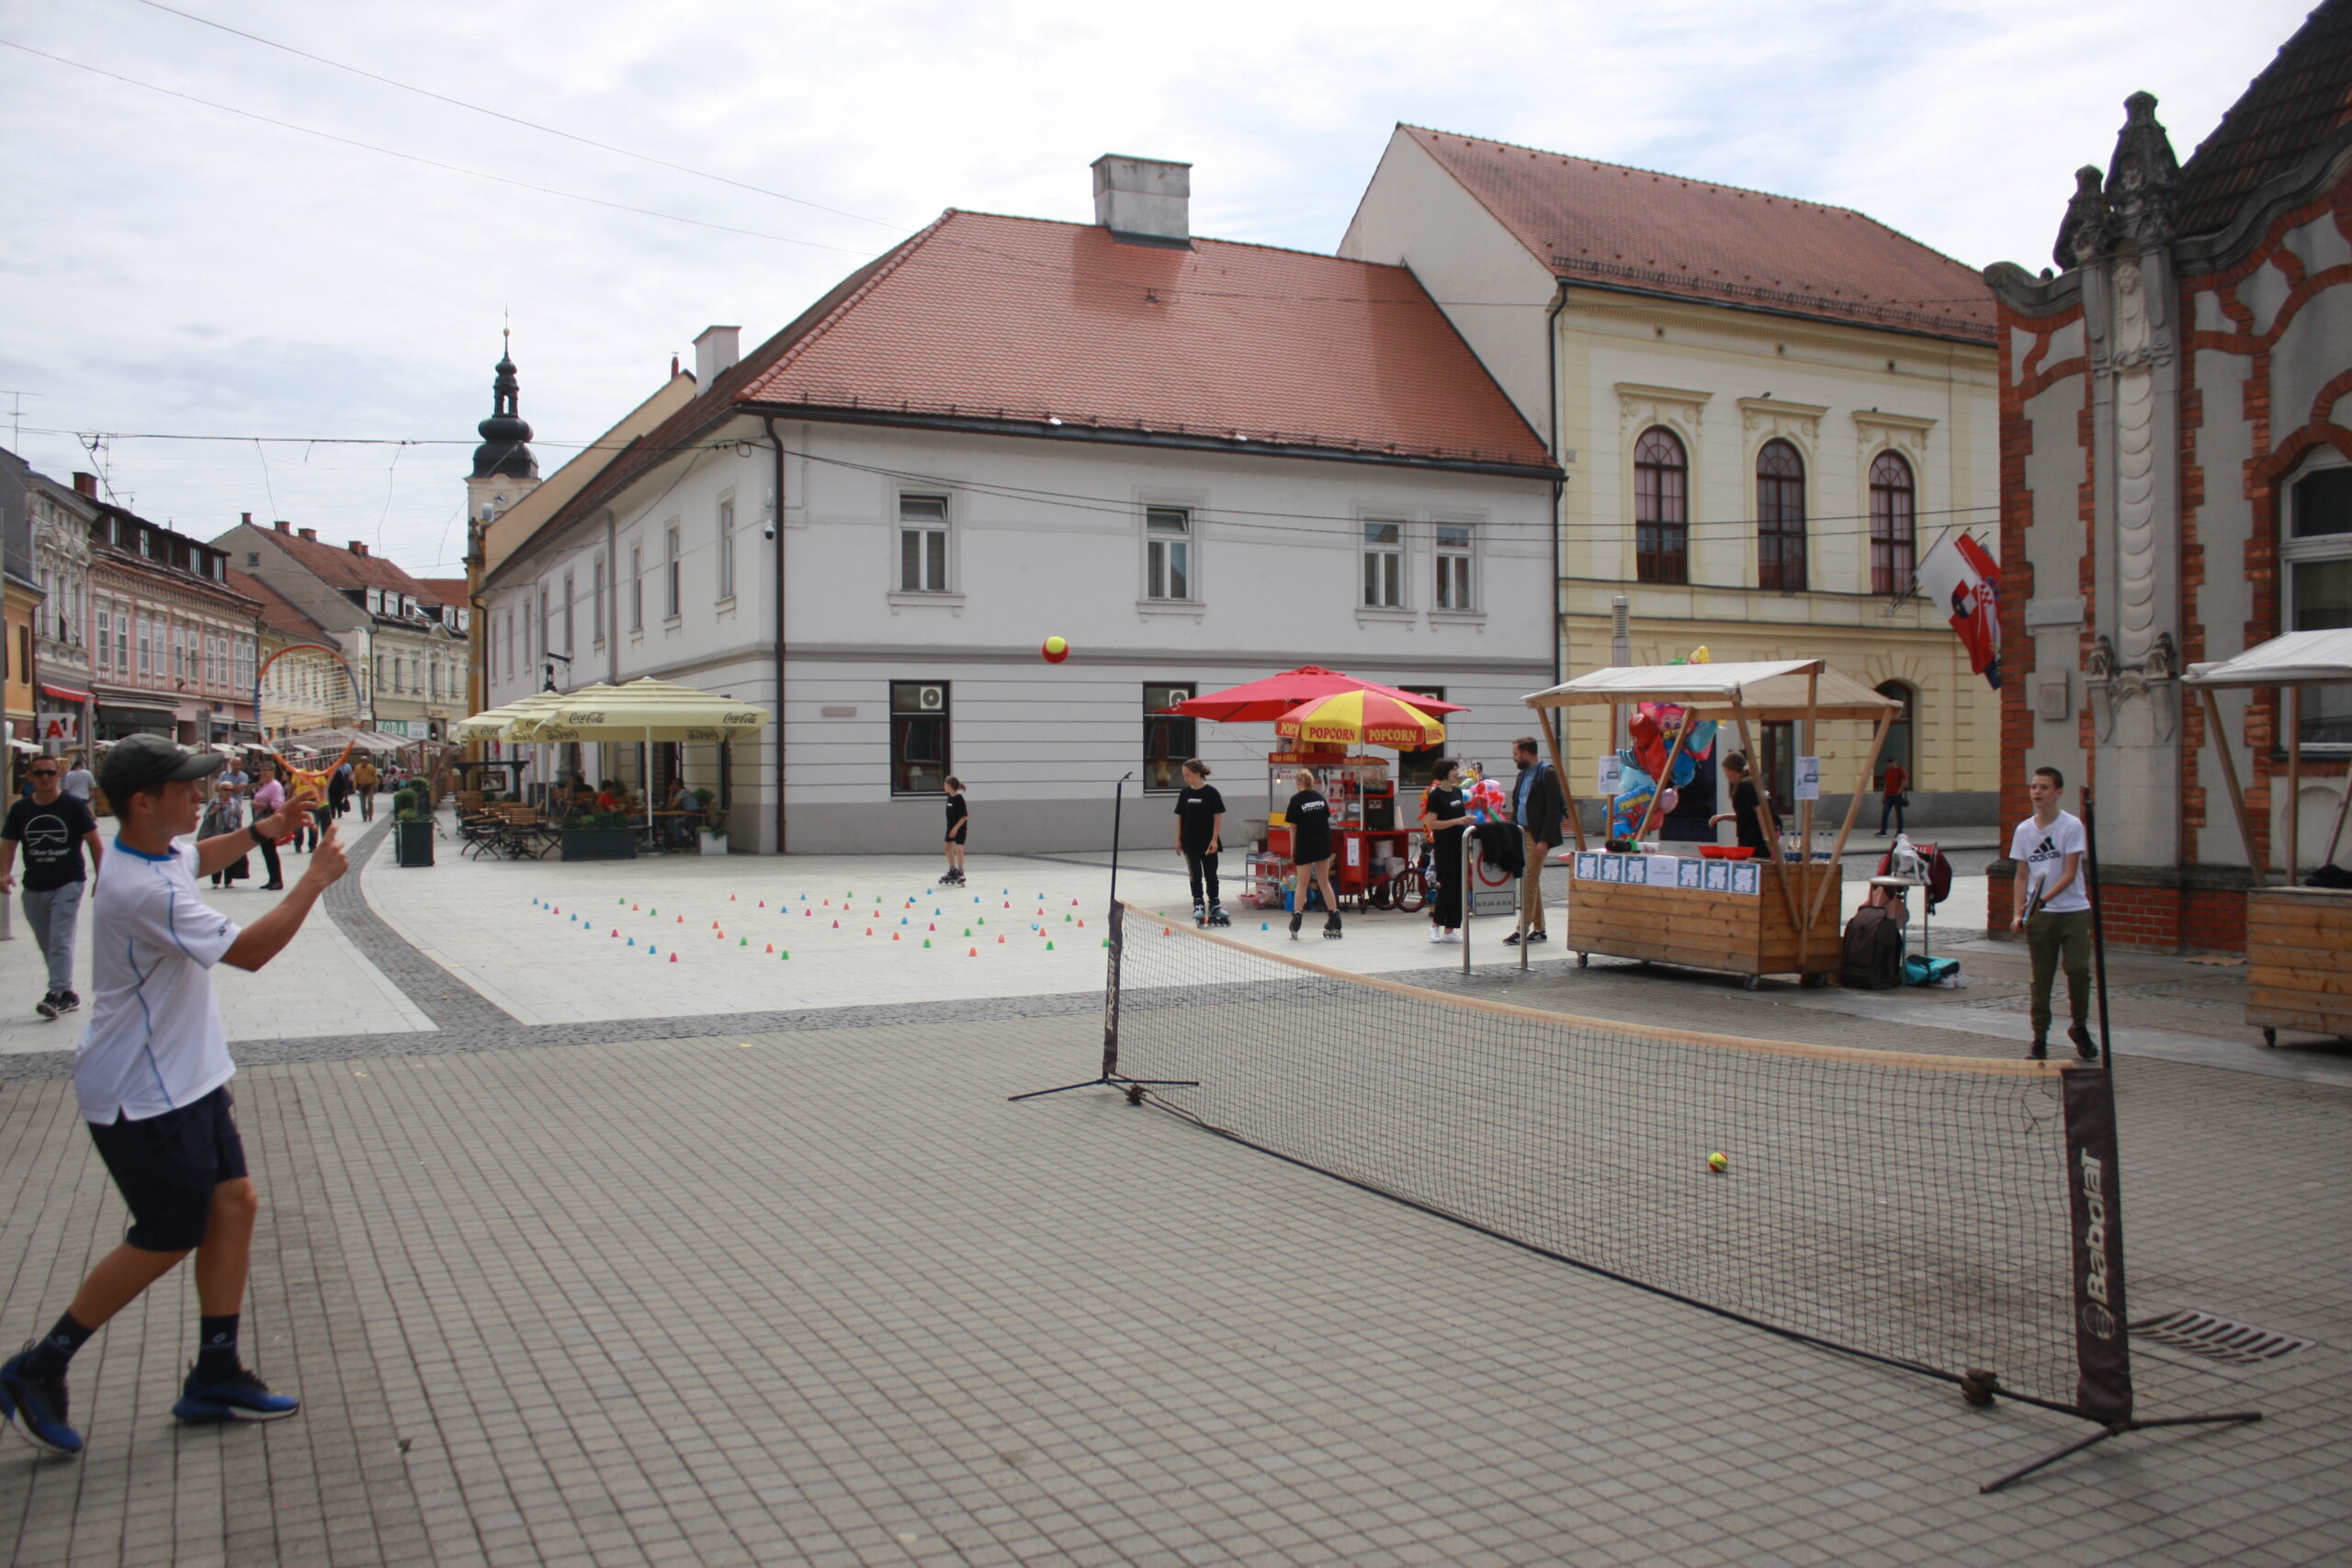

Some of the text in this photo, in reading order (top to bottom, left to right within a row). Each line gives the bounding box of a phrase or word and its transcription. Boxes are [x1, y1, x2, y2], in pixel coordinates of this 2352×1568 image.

[46, 717, 68, 739] A1
[1308, 727, 1356, 740] POPCORN
[1369, 728, 1417, 742] POPCORN
[2029, 850, 2061, 863] adidas
[2081, 1146, 2109, 1305] Babolat
